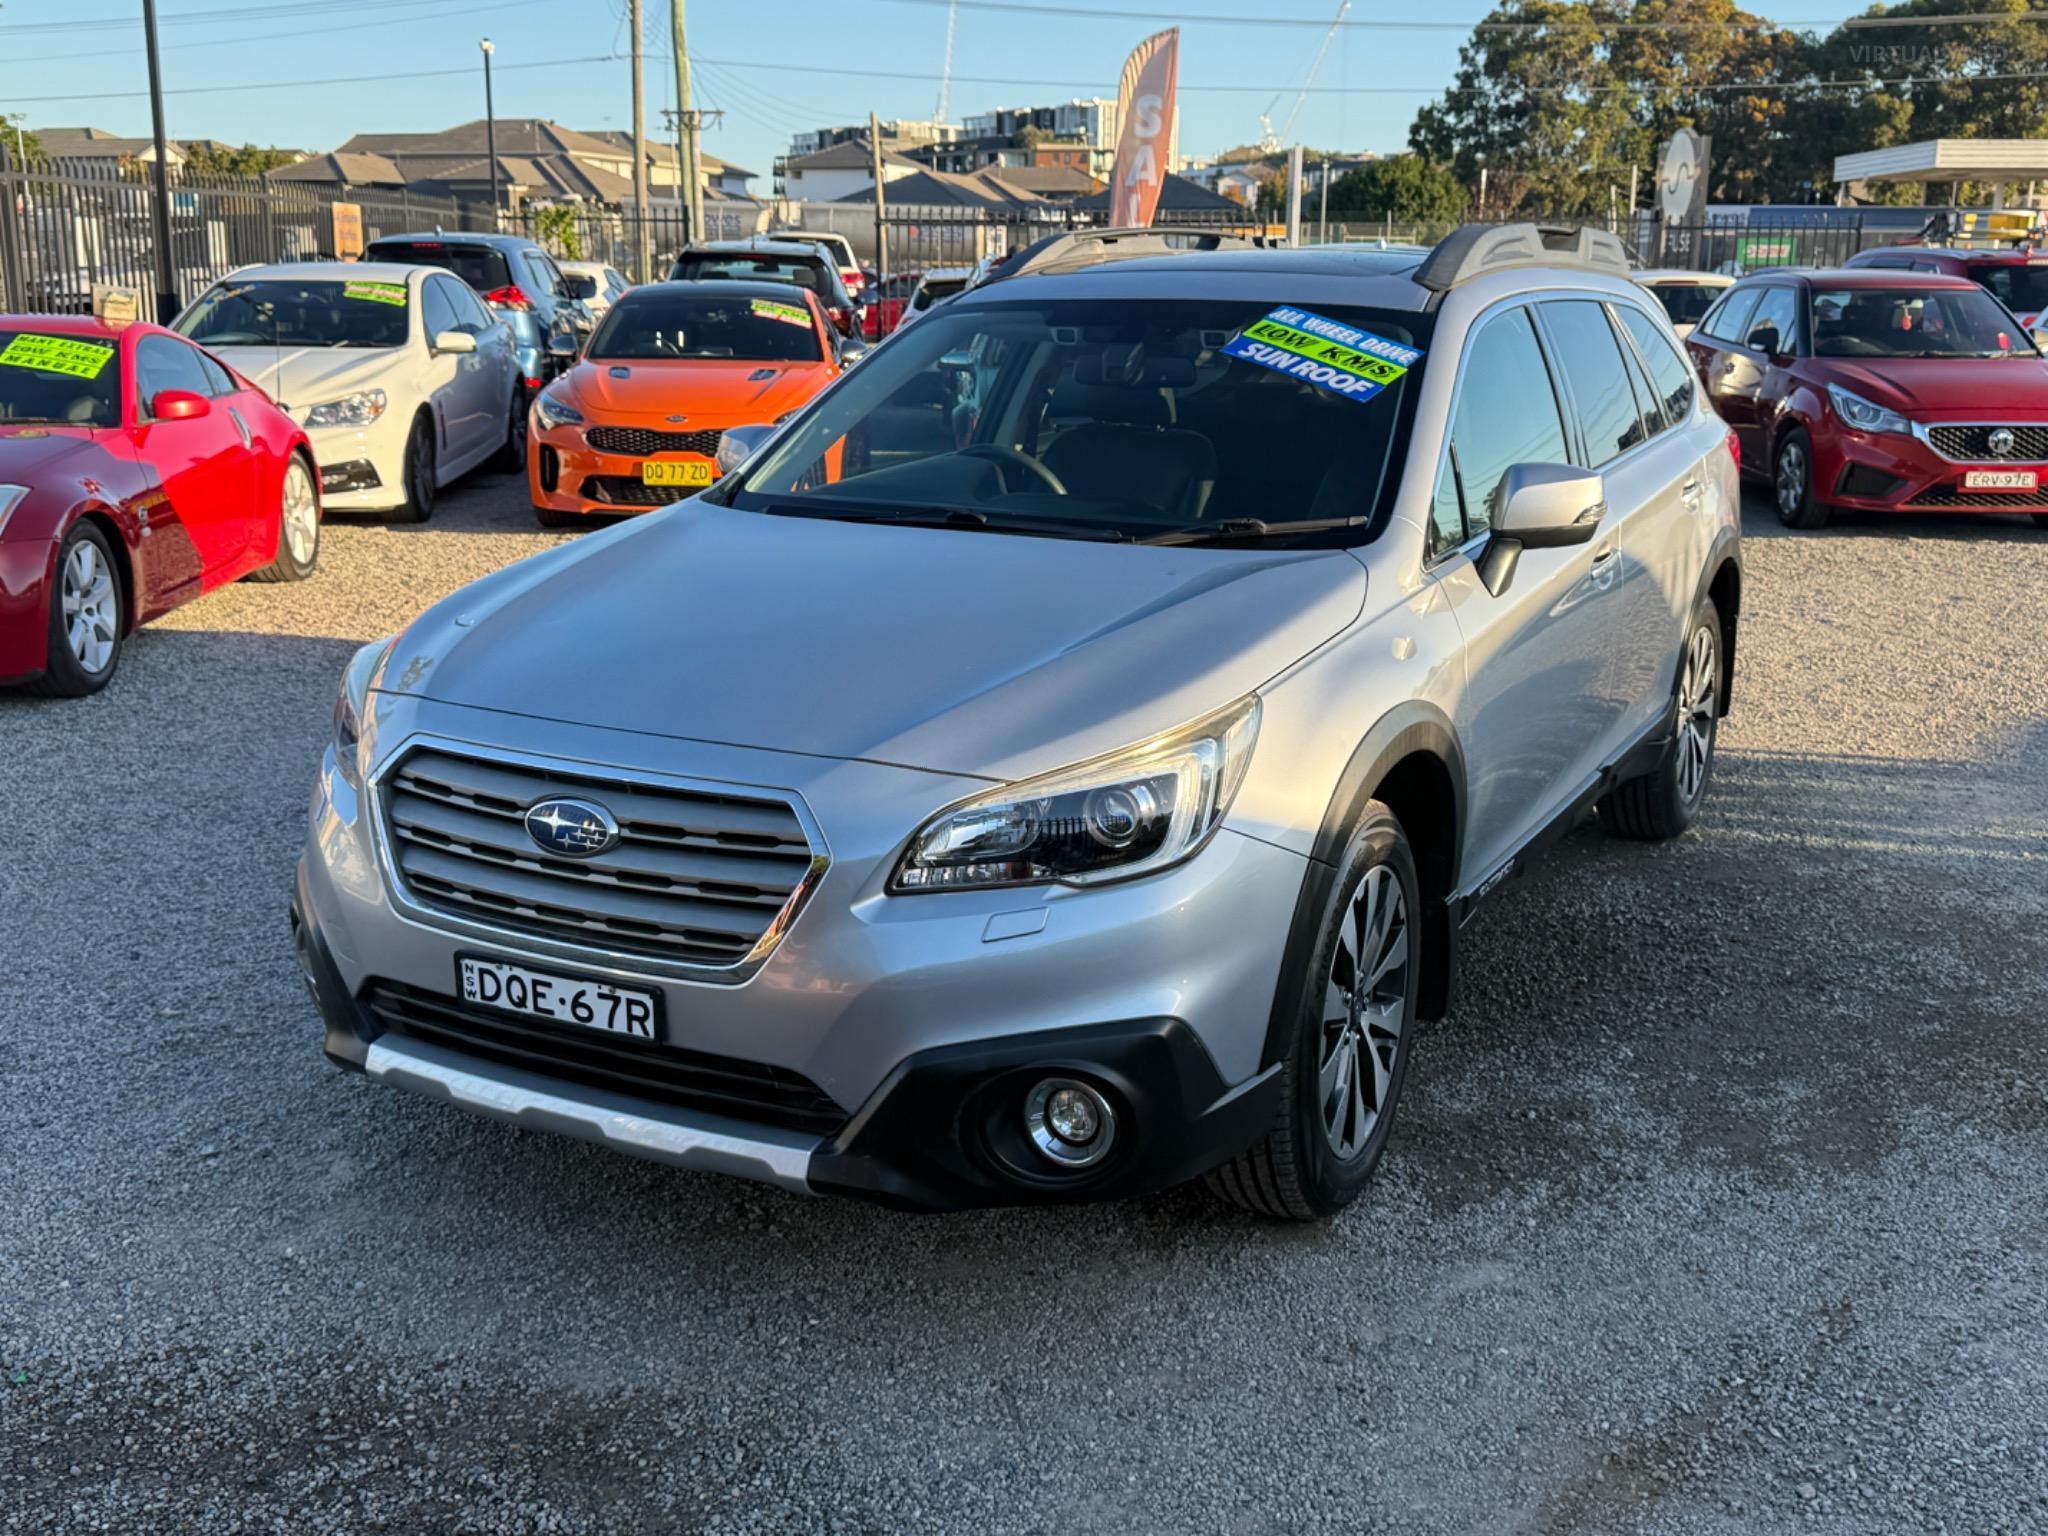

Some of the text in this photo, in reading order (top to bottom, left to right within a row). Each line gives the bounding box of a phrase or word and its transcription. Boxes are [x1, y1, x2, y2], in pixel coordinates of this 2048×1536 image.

[19, 335, 110, 356] MANY EXTRAS
[1268, 308, 1418, 365] ALL WHEEL DRIVE
[10, 345, 100, 365] LOW KMS
[1253, 323, 1396, 378] LOW KMS
[5, 354, 92, 375] MANUAL
